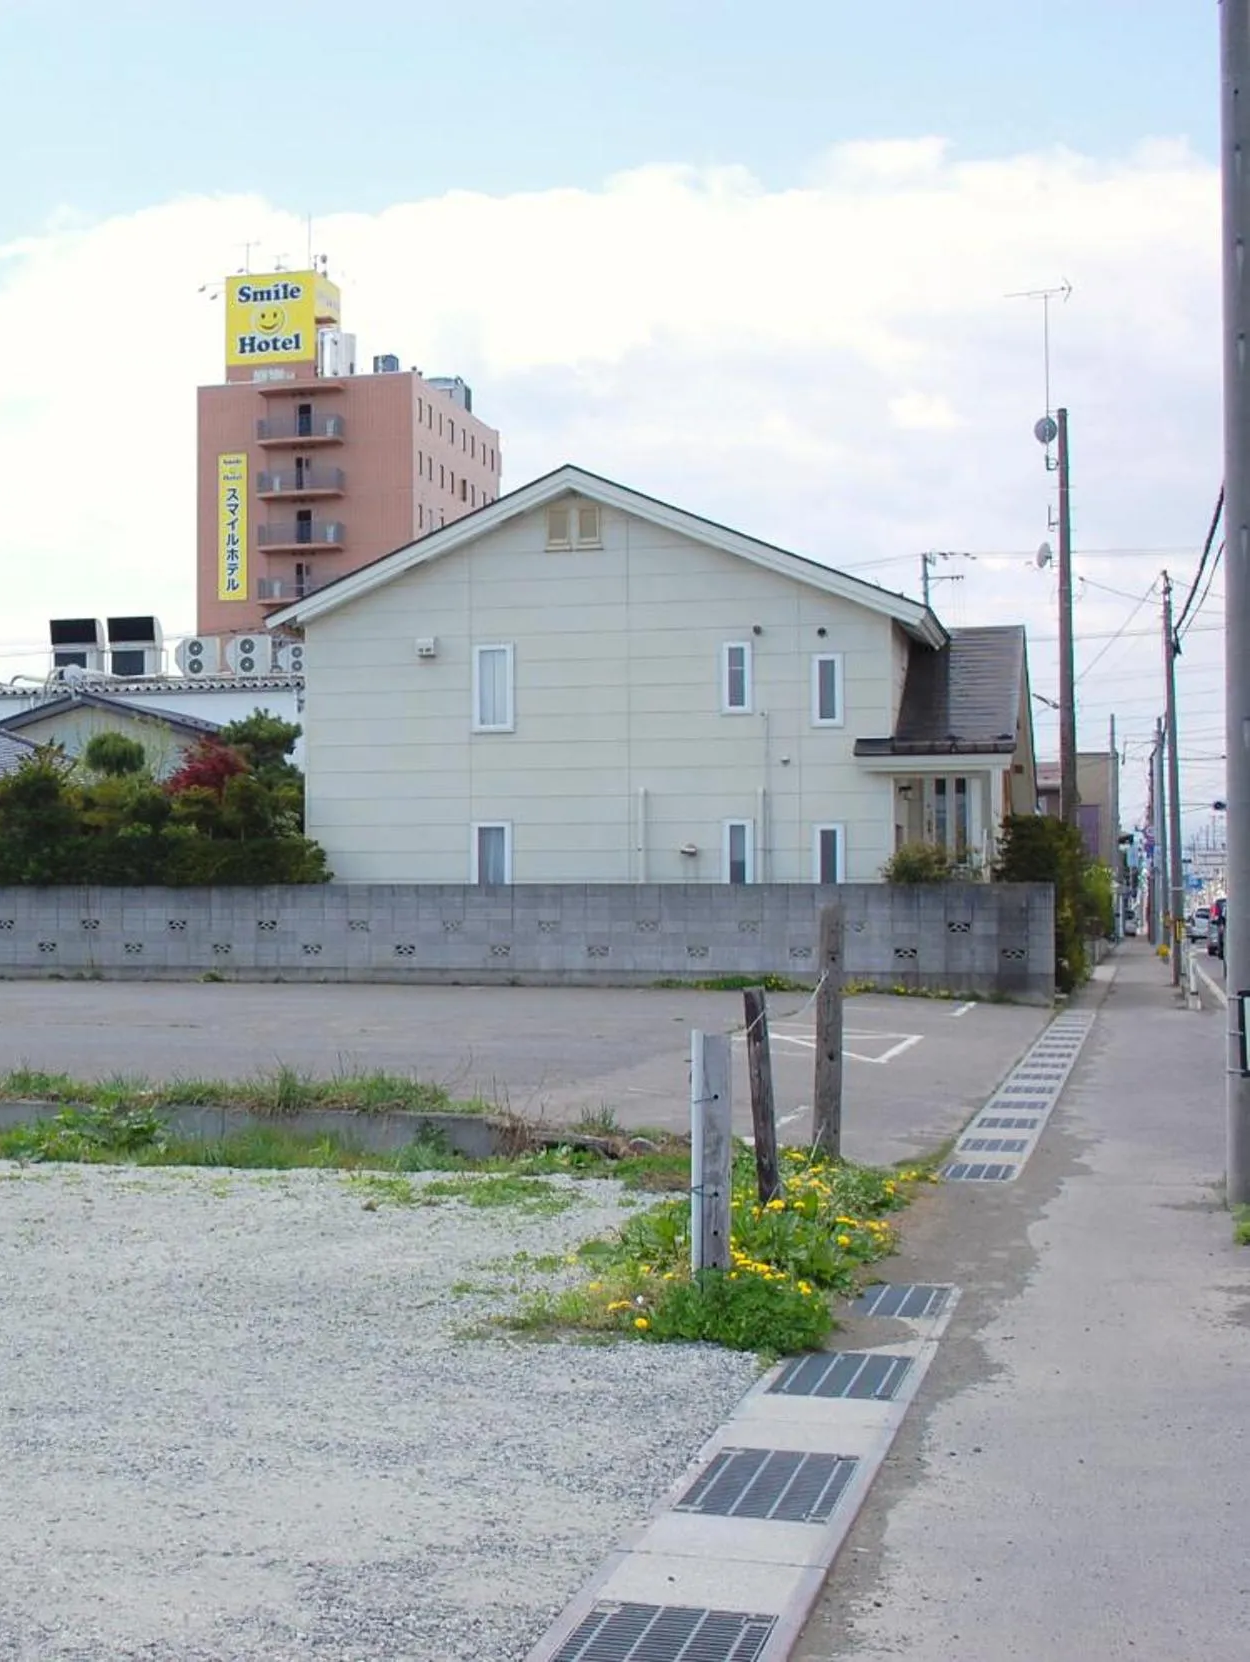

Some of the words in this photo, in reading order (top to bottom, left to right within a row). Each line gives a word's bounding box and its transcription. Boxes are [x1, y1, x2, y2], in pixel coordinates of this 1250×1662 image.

[238, 283, 301, 303] Smile
[238, 333, 301, 354] Hotel
[226, 487, 240, 592] スマイルホテル
